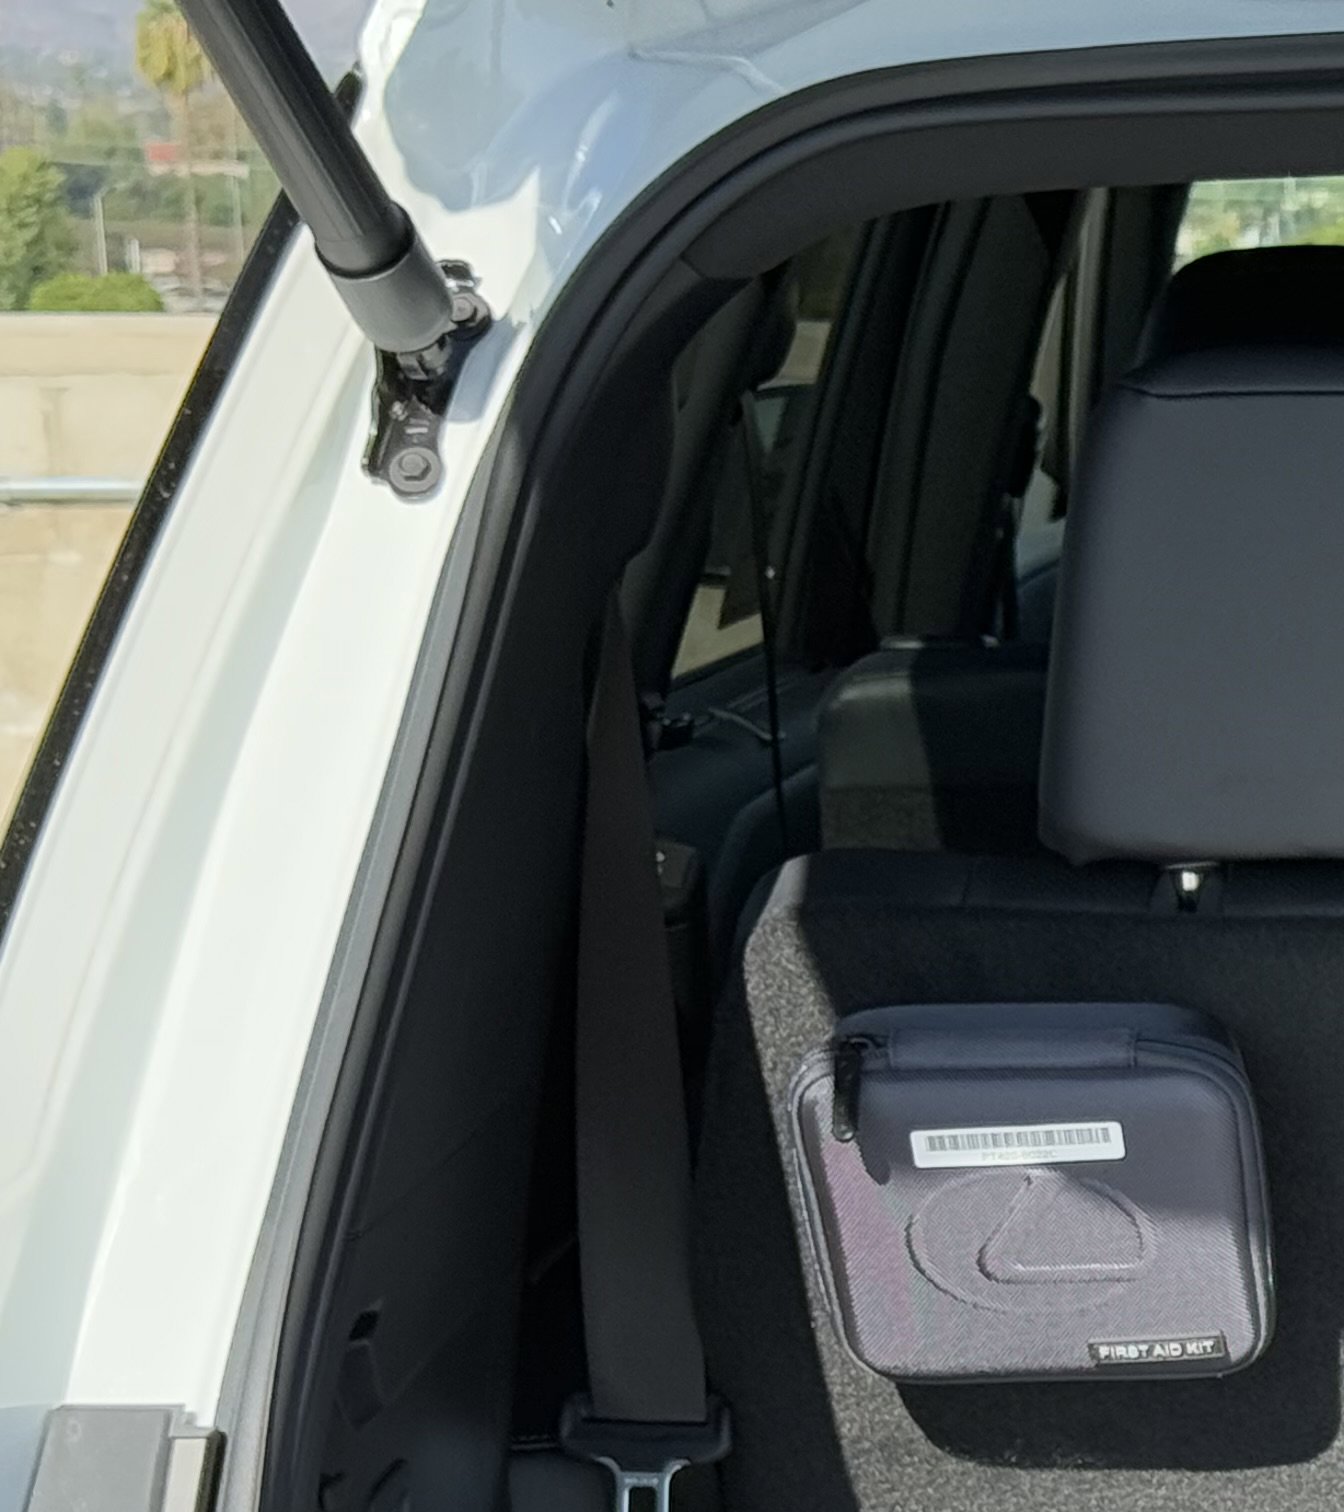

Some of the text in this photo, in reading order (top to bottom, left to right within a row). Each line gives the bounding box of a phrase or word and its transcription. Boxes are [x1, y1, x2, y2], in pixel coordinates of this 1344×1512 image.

[1099, 1340, 1215, 1360] FIRST AID KIT
